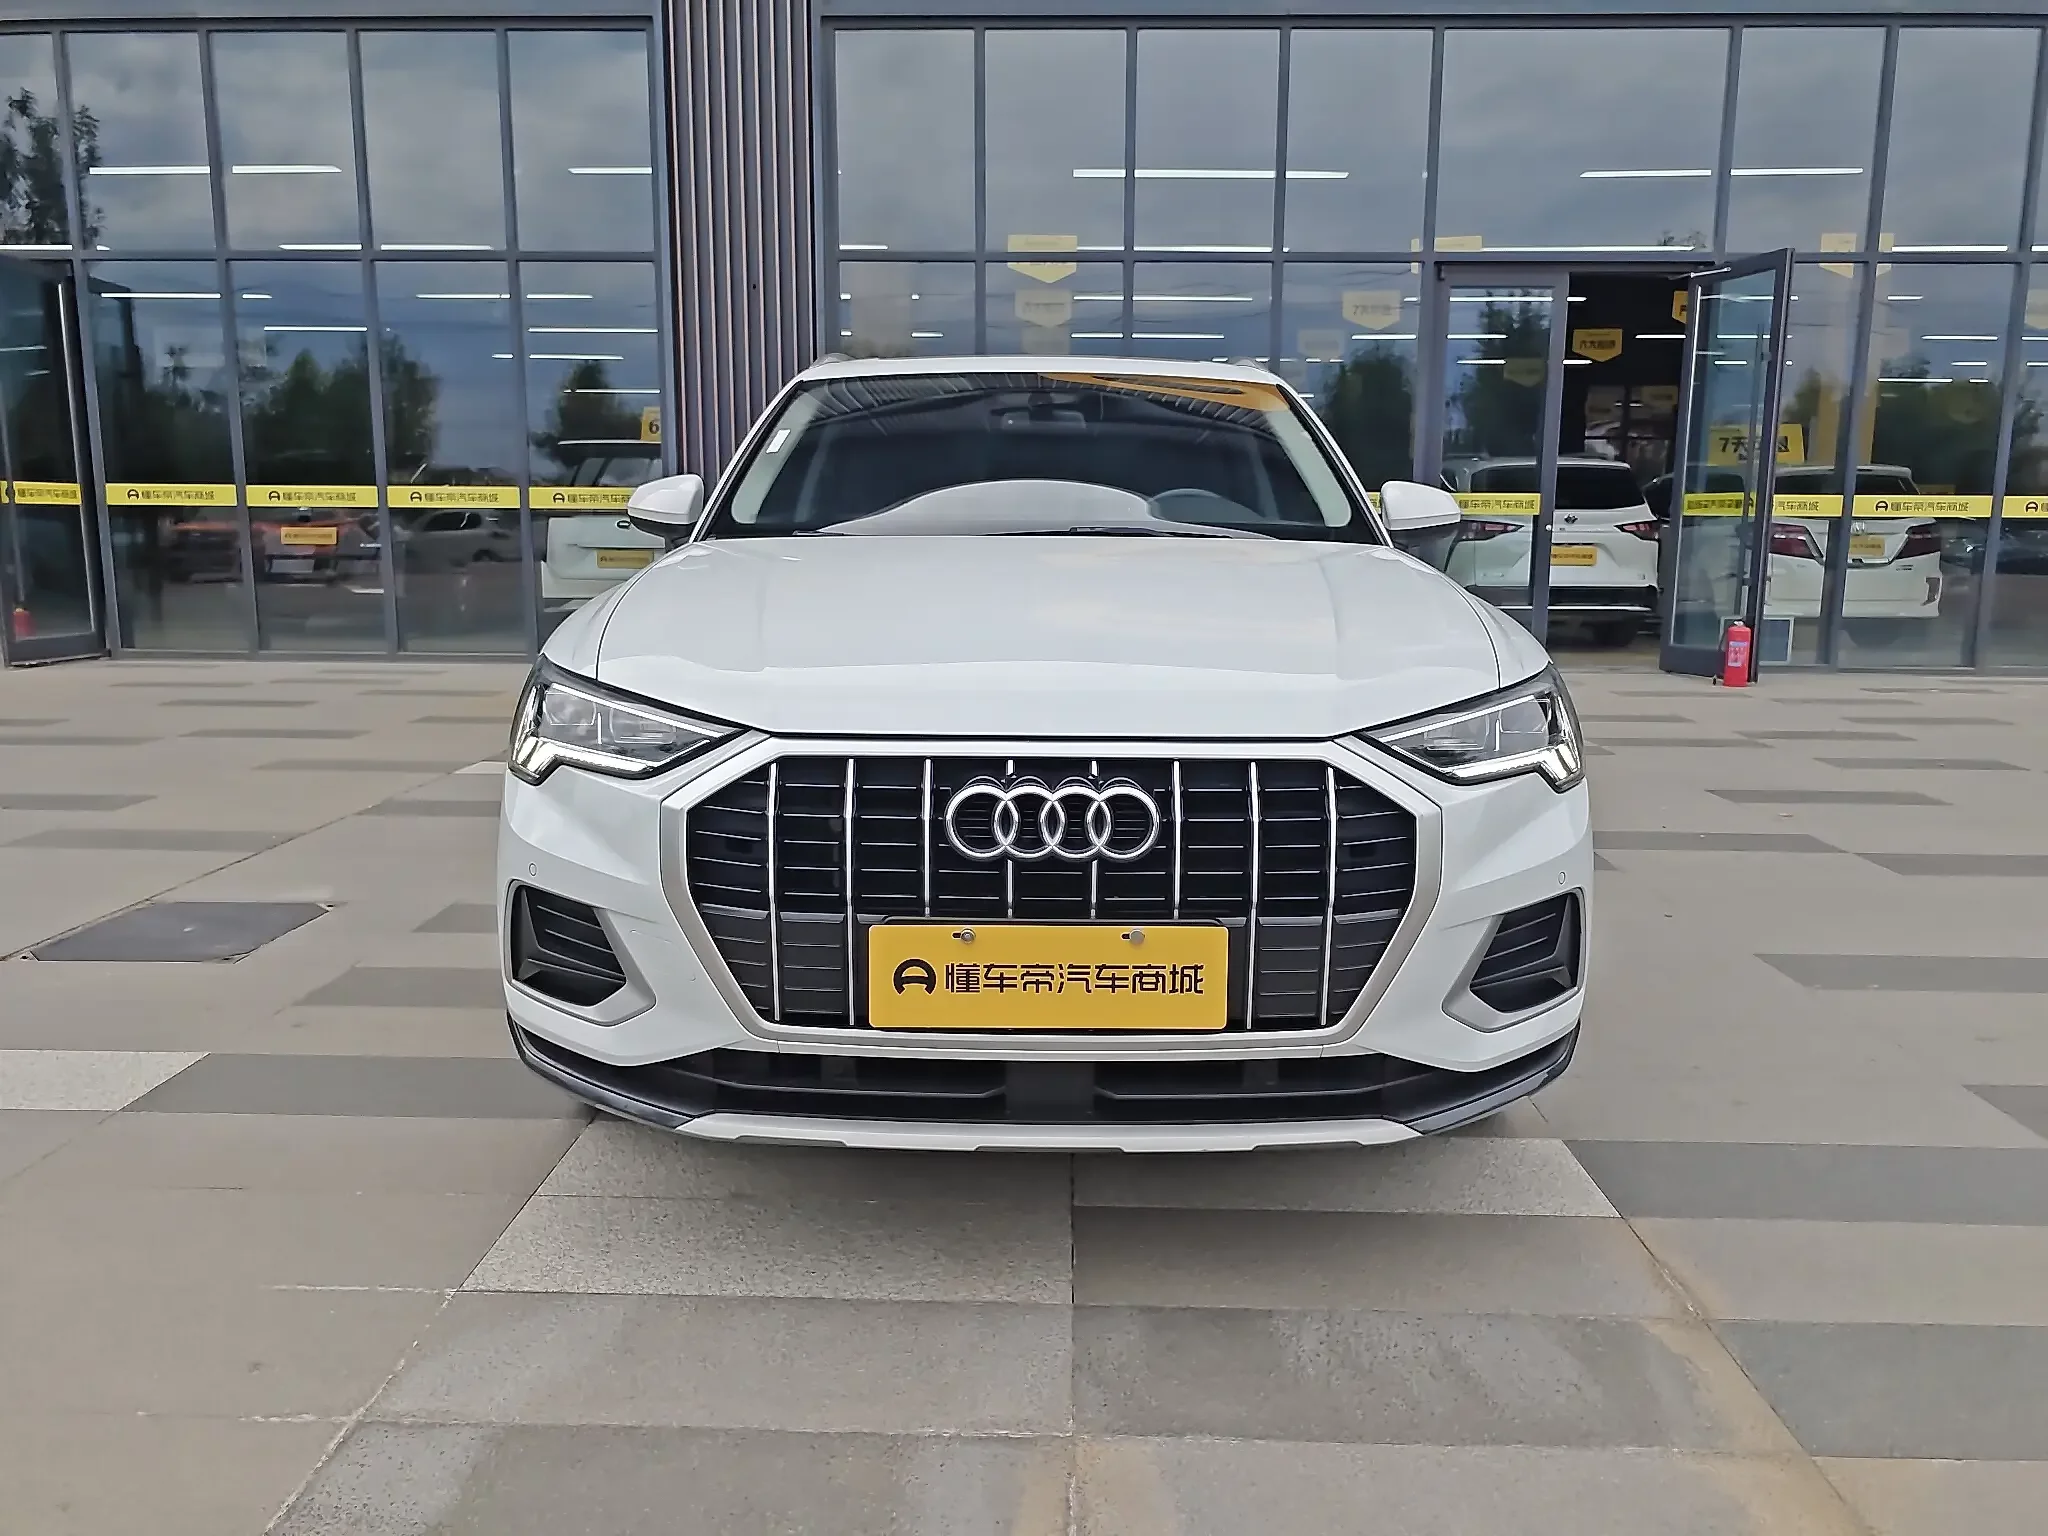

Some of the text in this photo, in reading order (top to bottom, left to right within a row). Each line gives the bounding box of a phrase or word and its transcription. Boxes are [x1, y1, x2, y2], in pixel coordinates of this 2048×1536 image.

[649, 420, 660, 435] 6
[944, 962, 1205, 995] 懂车帝汽车商城
